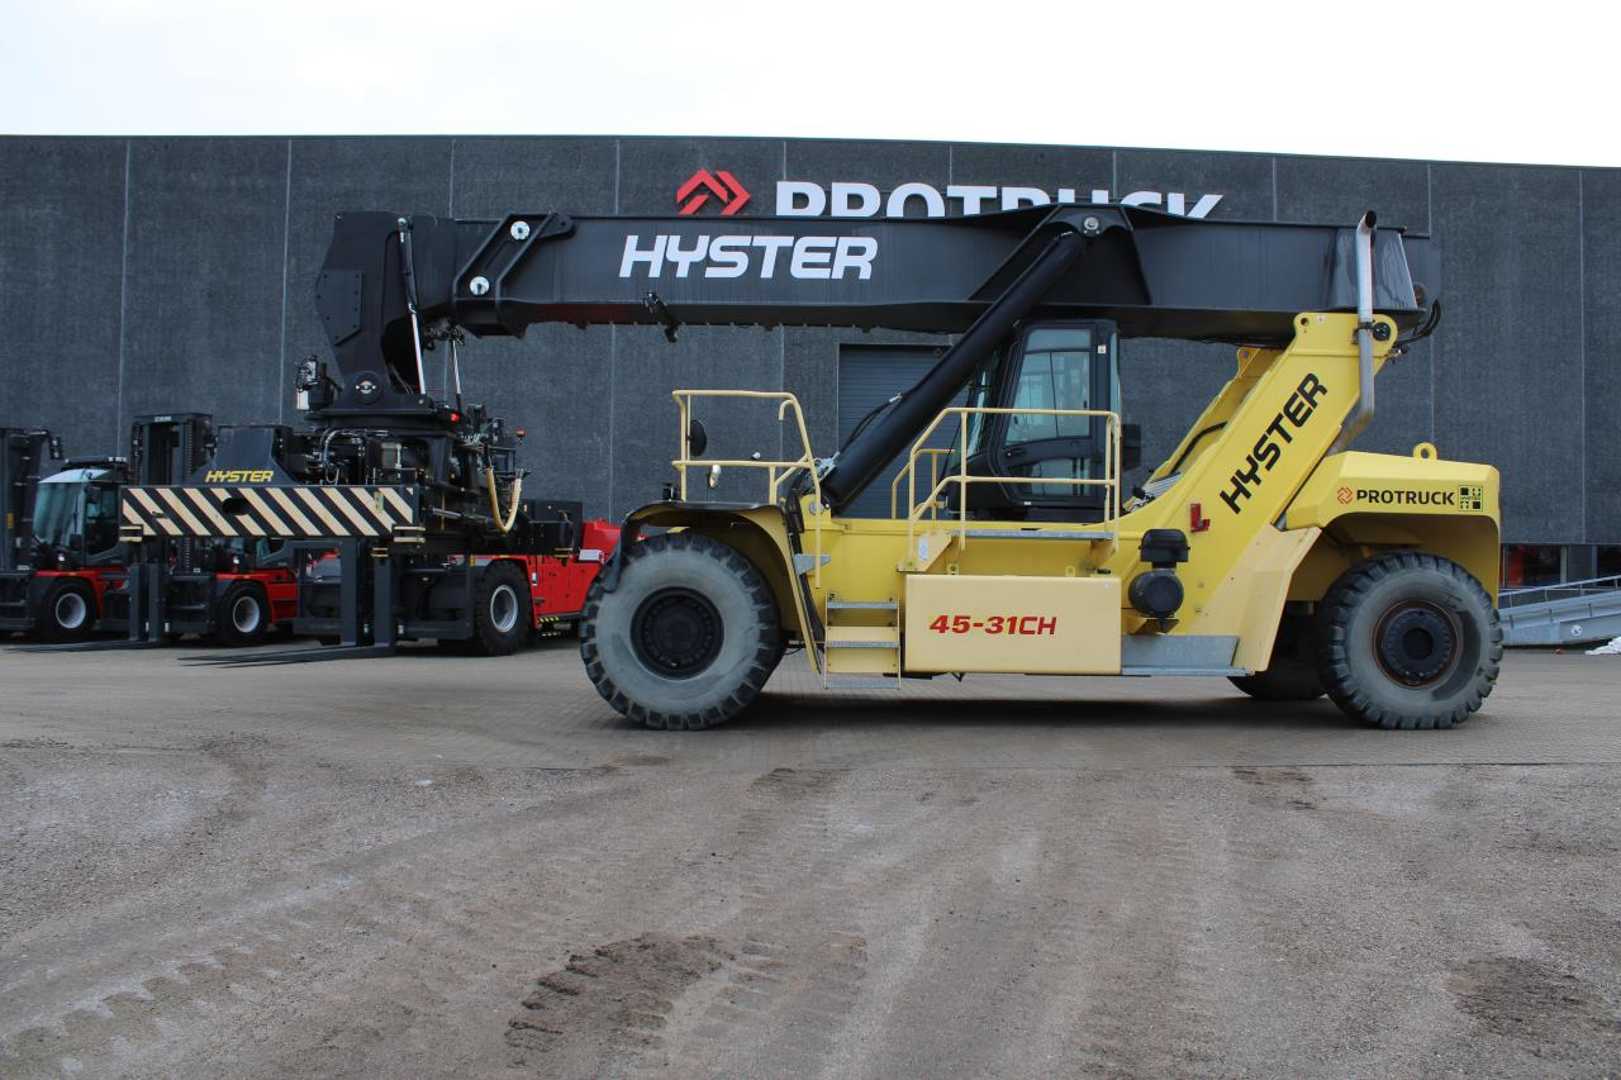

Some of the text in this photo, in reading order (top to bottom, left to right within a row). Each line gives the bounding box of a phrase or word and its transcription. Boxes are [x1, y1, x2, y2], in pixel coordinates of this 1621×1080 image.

[776, 181, 1224, 218] PROT
[618, 234, 879, 280] HYSTER
[1219, 372, 1328, 515] HYSTER
[204, 470, 274, 483] HYSTER
[1356, 489, 1455, 505] PROTRUCK
[929, 614, 1057, 635] 45-31CH
